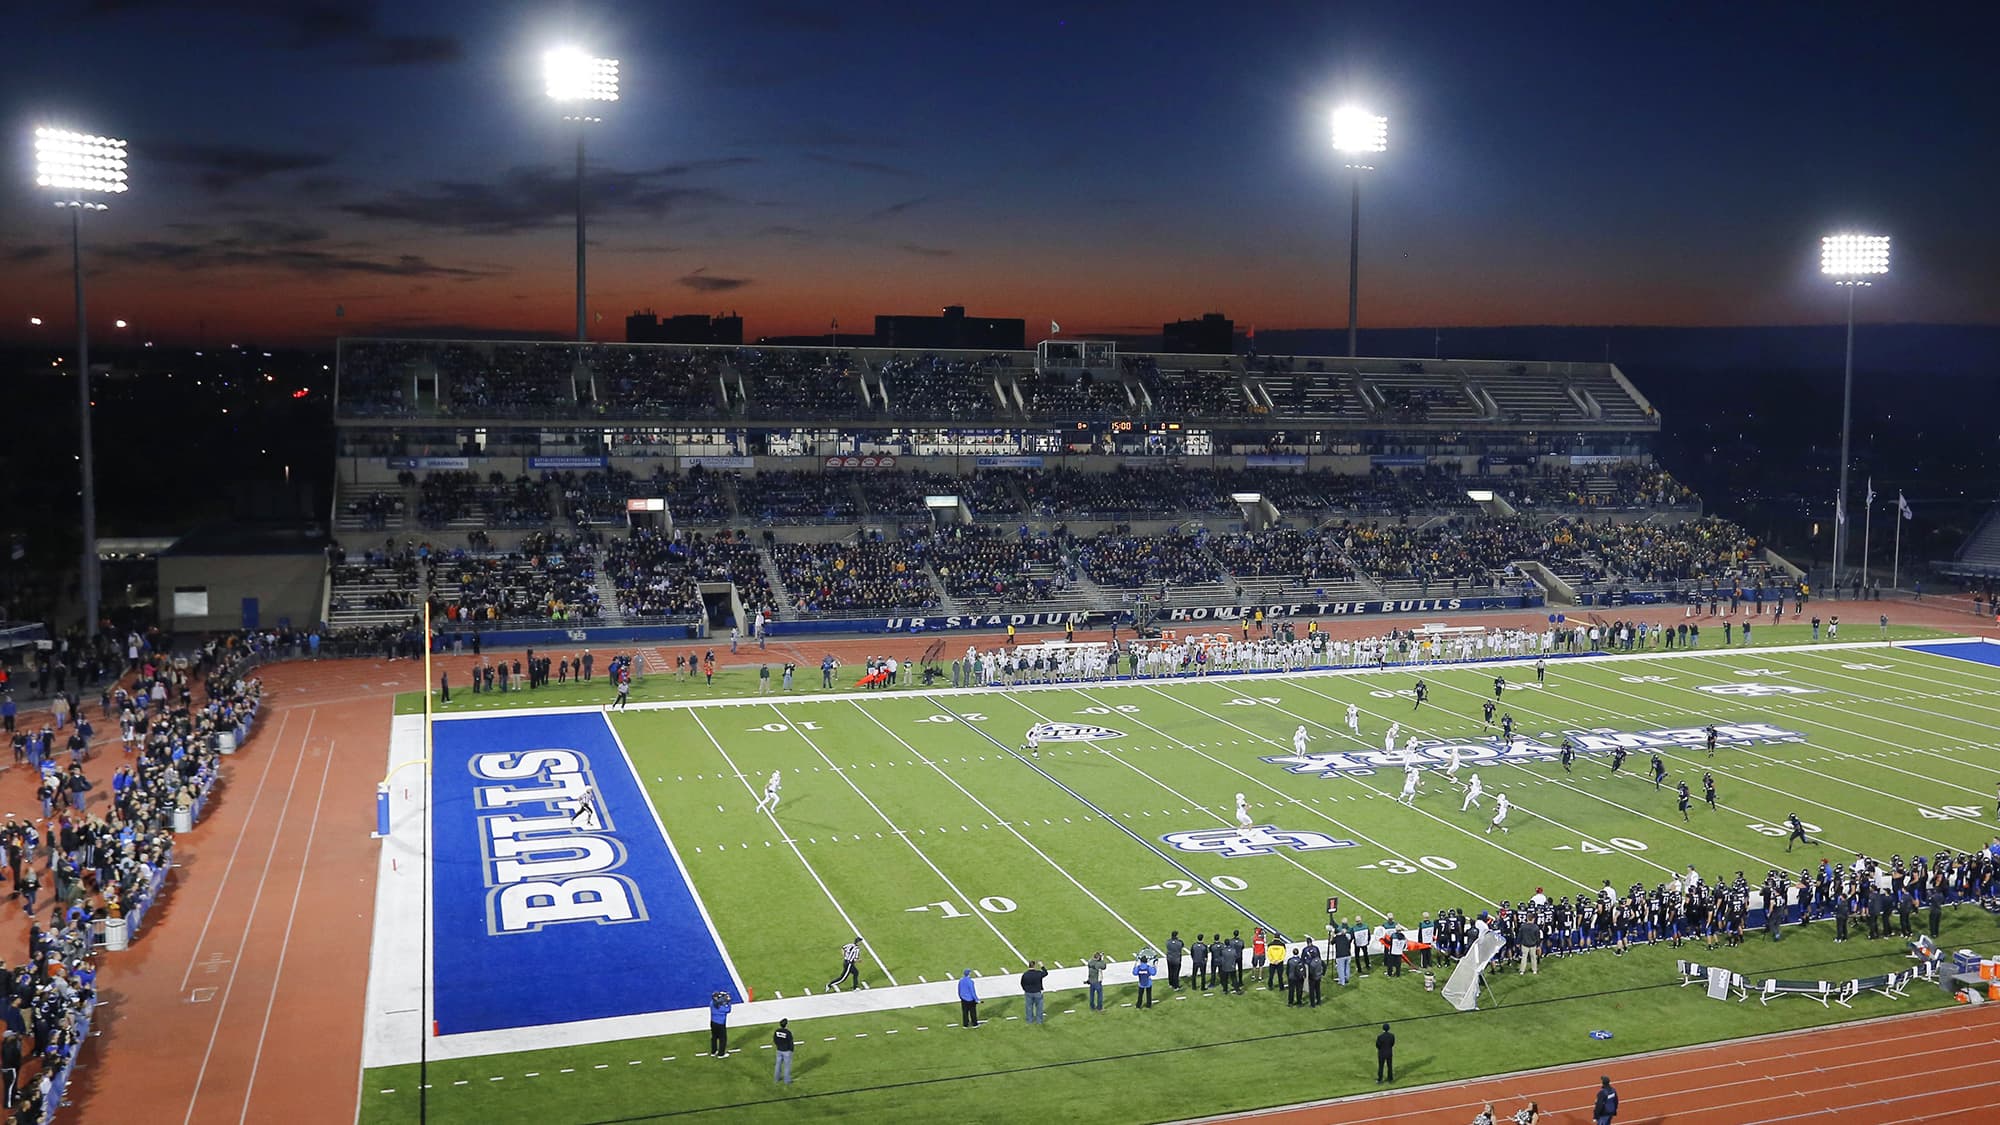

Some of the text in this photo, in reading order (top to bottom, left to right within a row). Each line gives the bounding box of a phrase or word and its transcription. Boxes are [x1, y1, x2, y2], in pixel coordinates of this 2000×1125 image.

[1111, 422, 1132, 430] 15:00
[946, 612, 1085, 628] STADIUM
[1170, 606, 1251, 621] HOME
[1269, 604, 1301, 617] OF
[1317, 602, 1366, 615] THE
[1382, 599, 1462, 612] BULLS
[762, 721, 823, 732] 10
[928, 712, 988, 723] 20
[1259, 722, 1807, 774] NEW YORK
[1918, 804, 1982, 820] 40
[468, 749, 650, 936] BULLS
[1158, 824, 1362, 858] UB
[1580, 837, 1650, 855] 40
[1378, 855, 1458, 875] 30
[1162, 875, 1249, 897] 20
[928, 896, 1018, 919] 10
